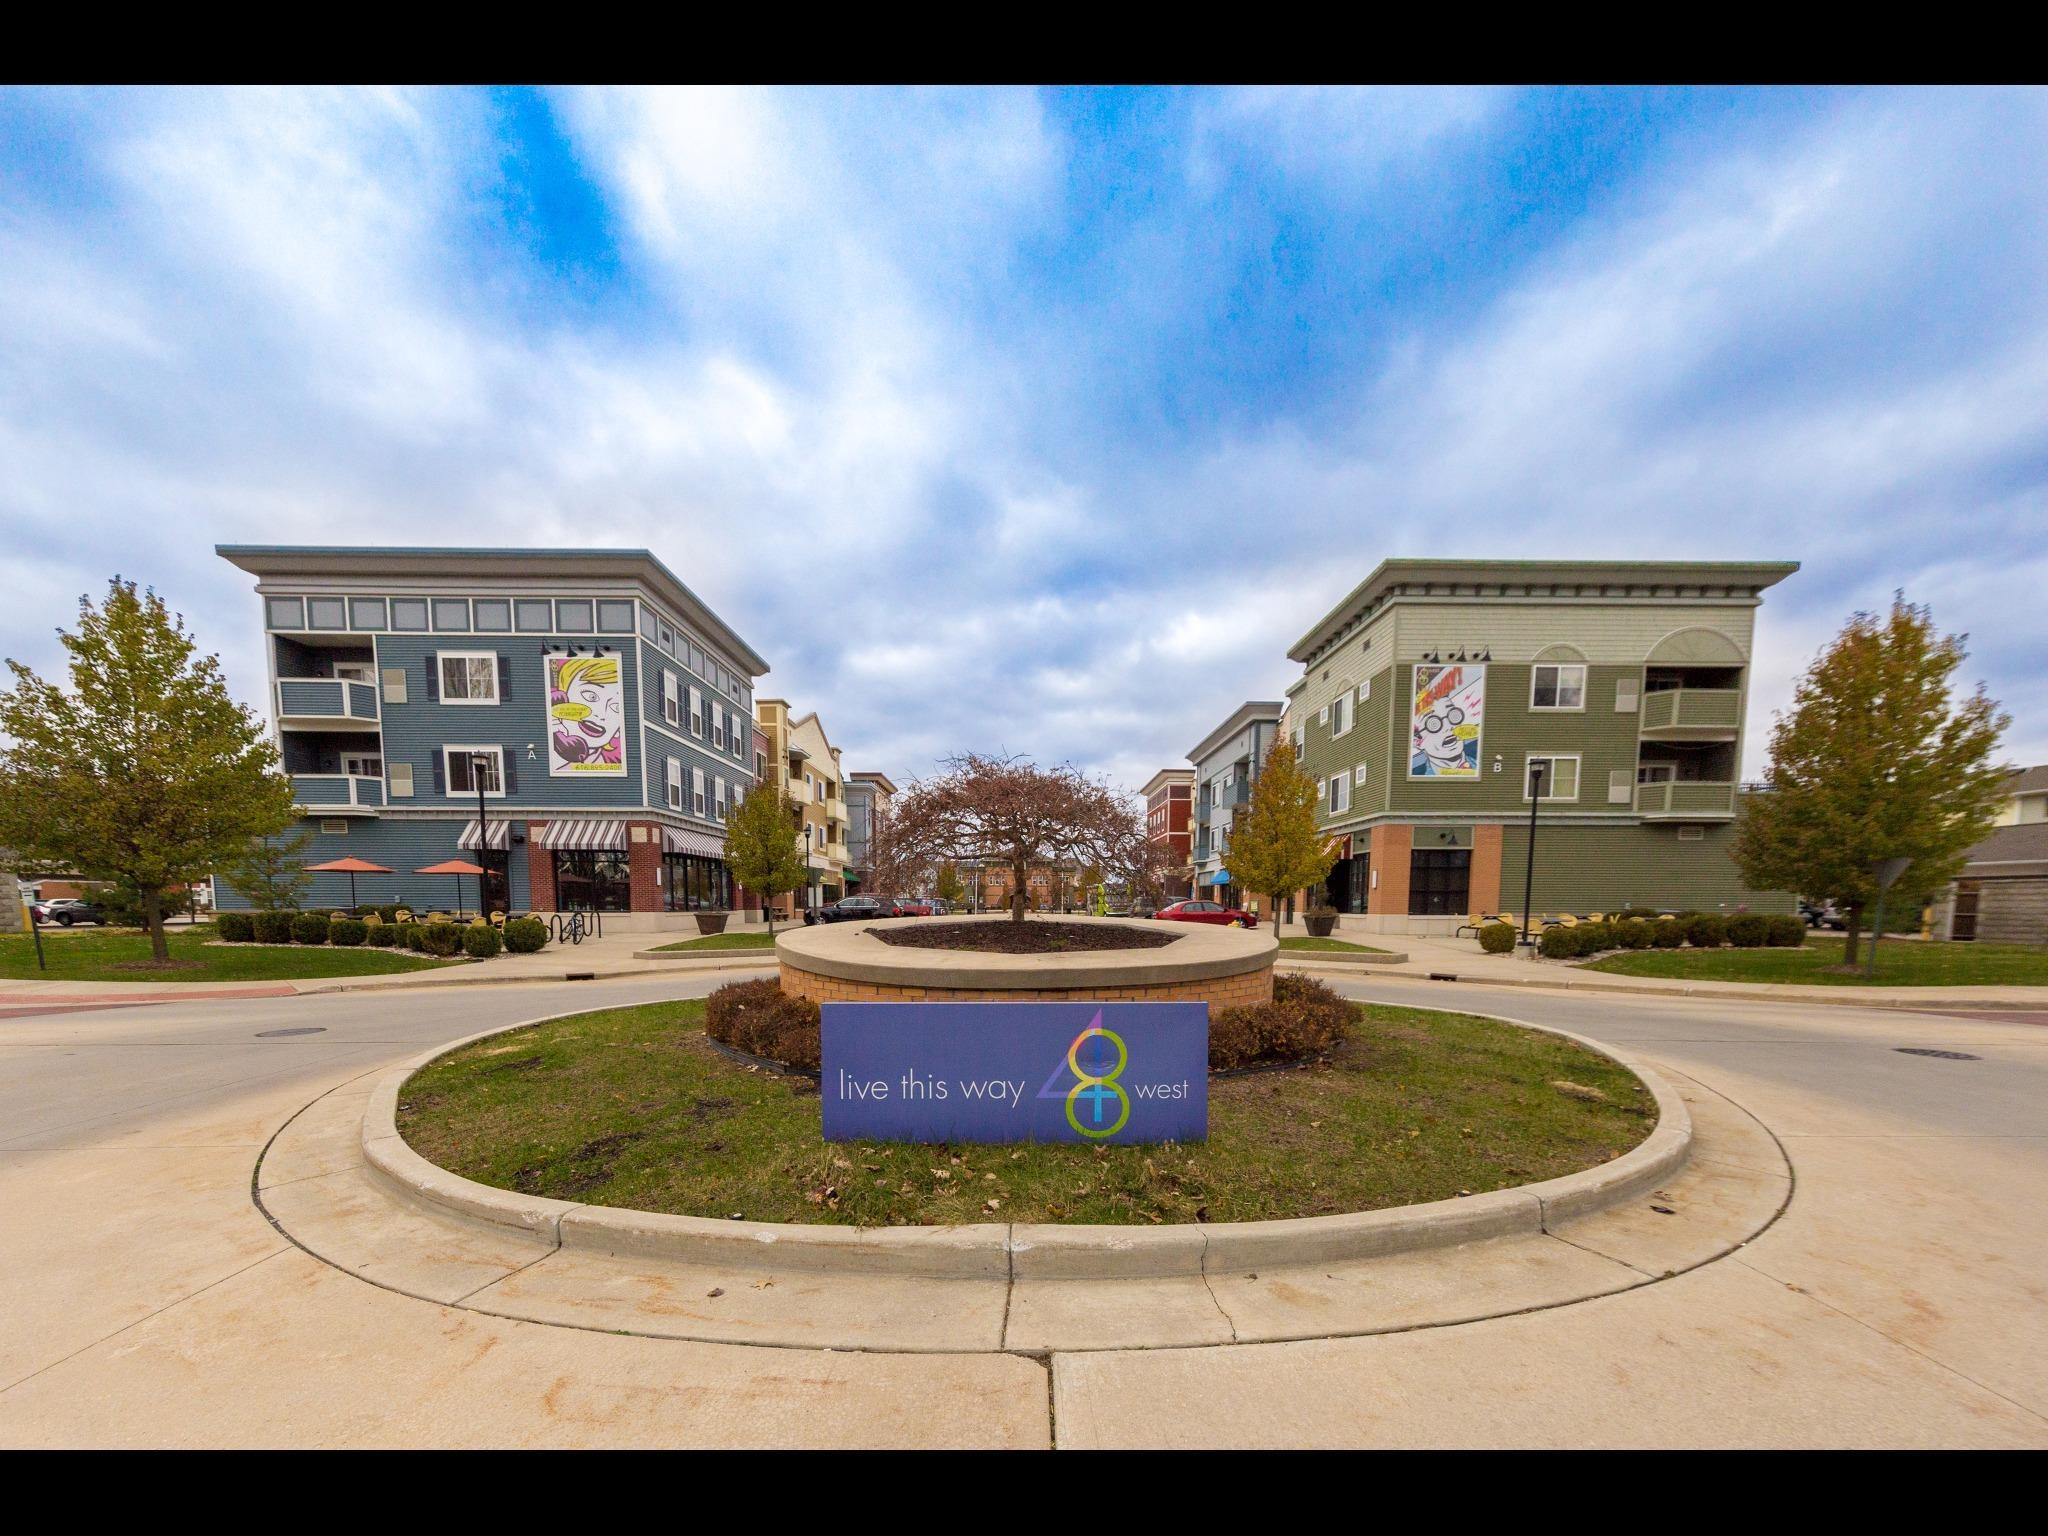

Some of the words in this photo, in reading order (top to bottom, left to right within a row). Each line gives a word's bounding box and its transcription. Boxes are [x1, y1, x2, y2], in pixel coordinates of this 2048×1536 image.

[527, 750, 537, 760] A
[1493, 762, 1502, 773] B
[839, 1068, 889, 1100] live
[901, 1068, 948, 1100] this
[960, 1079, 1026, 1108] way
[1134, 1078, 1189, 1100] west
